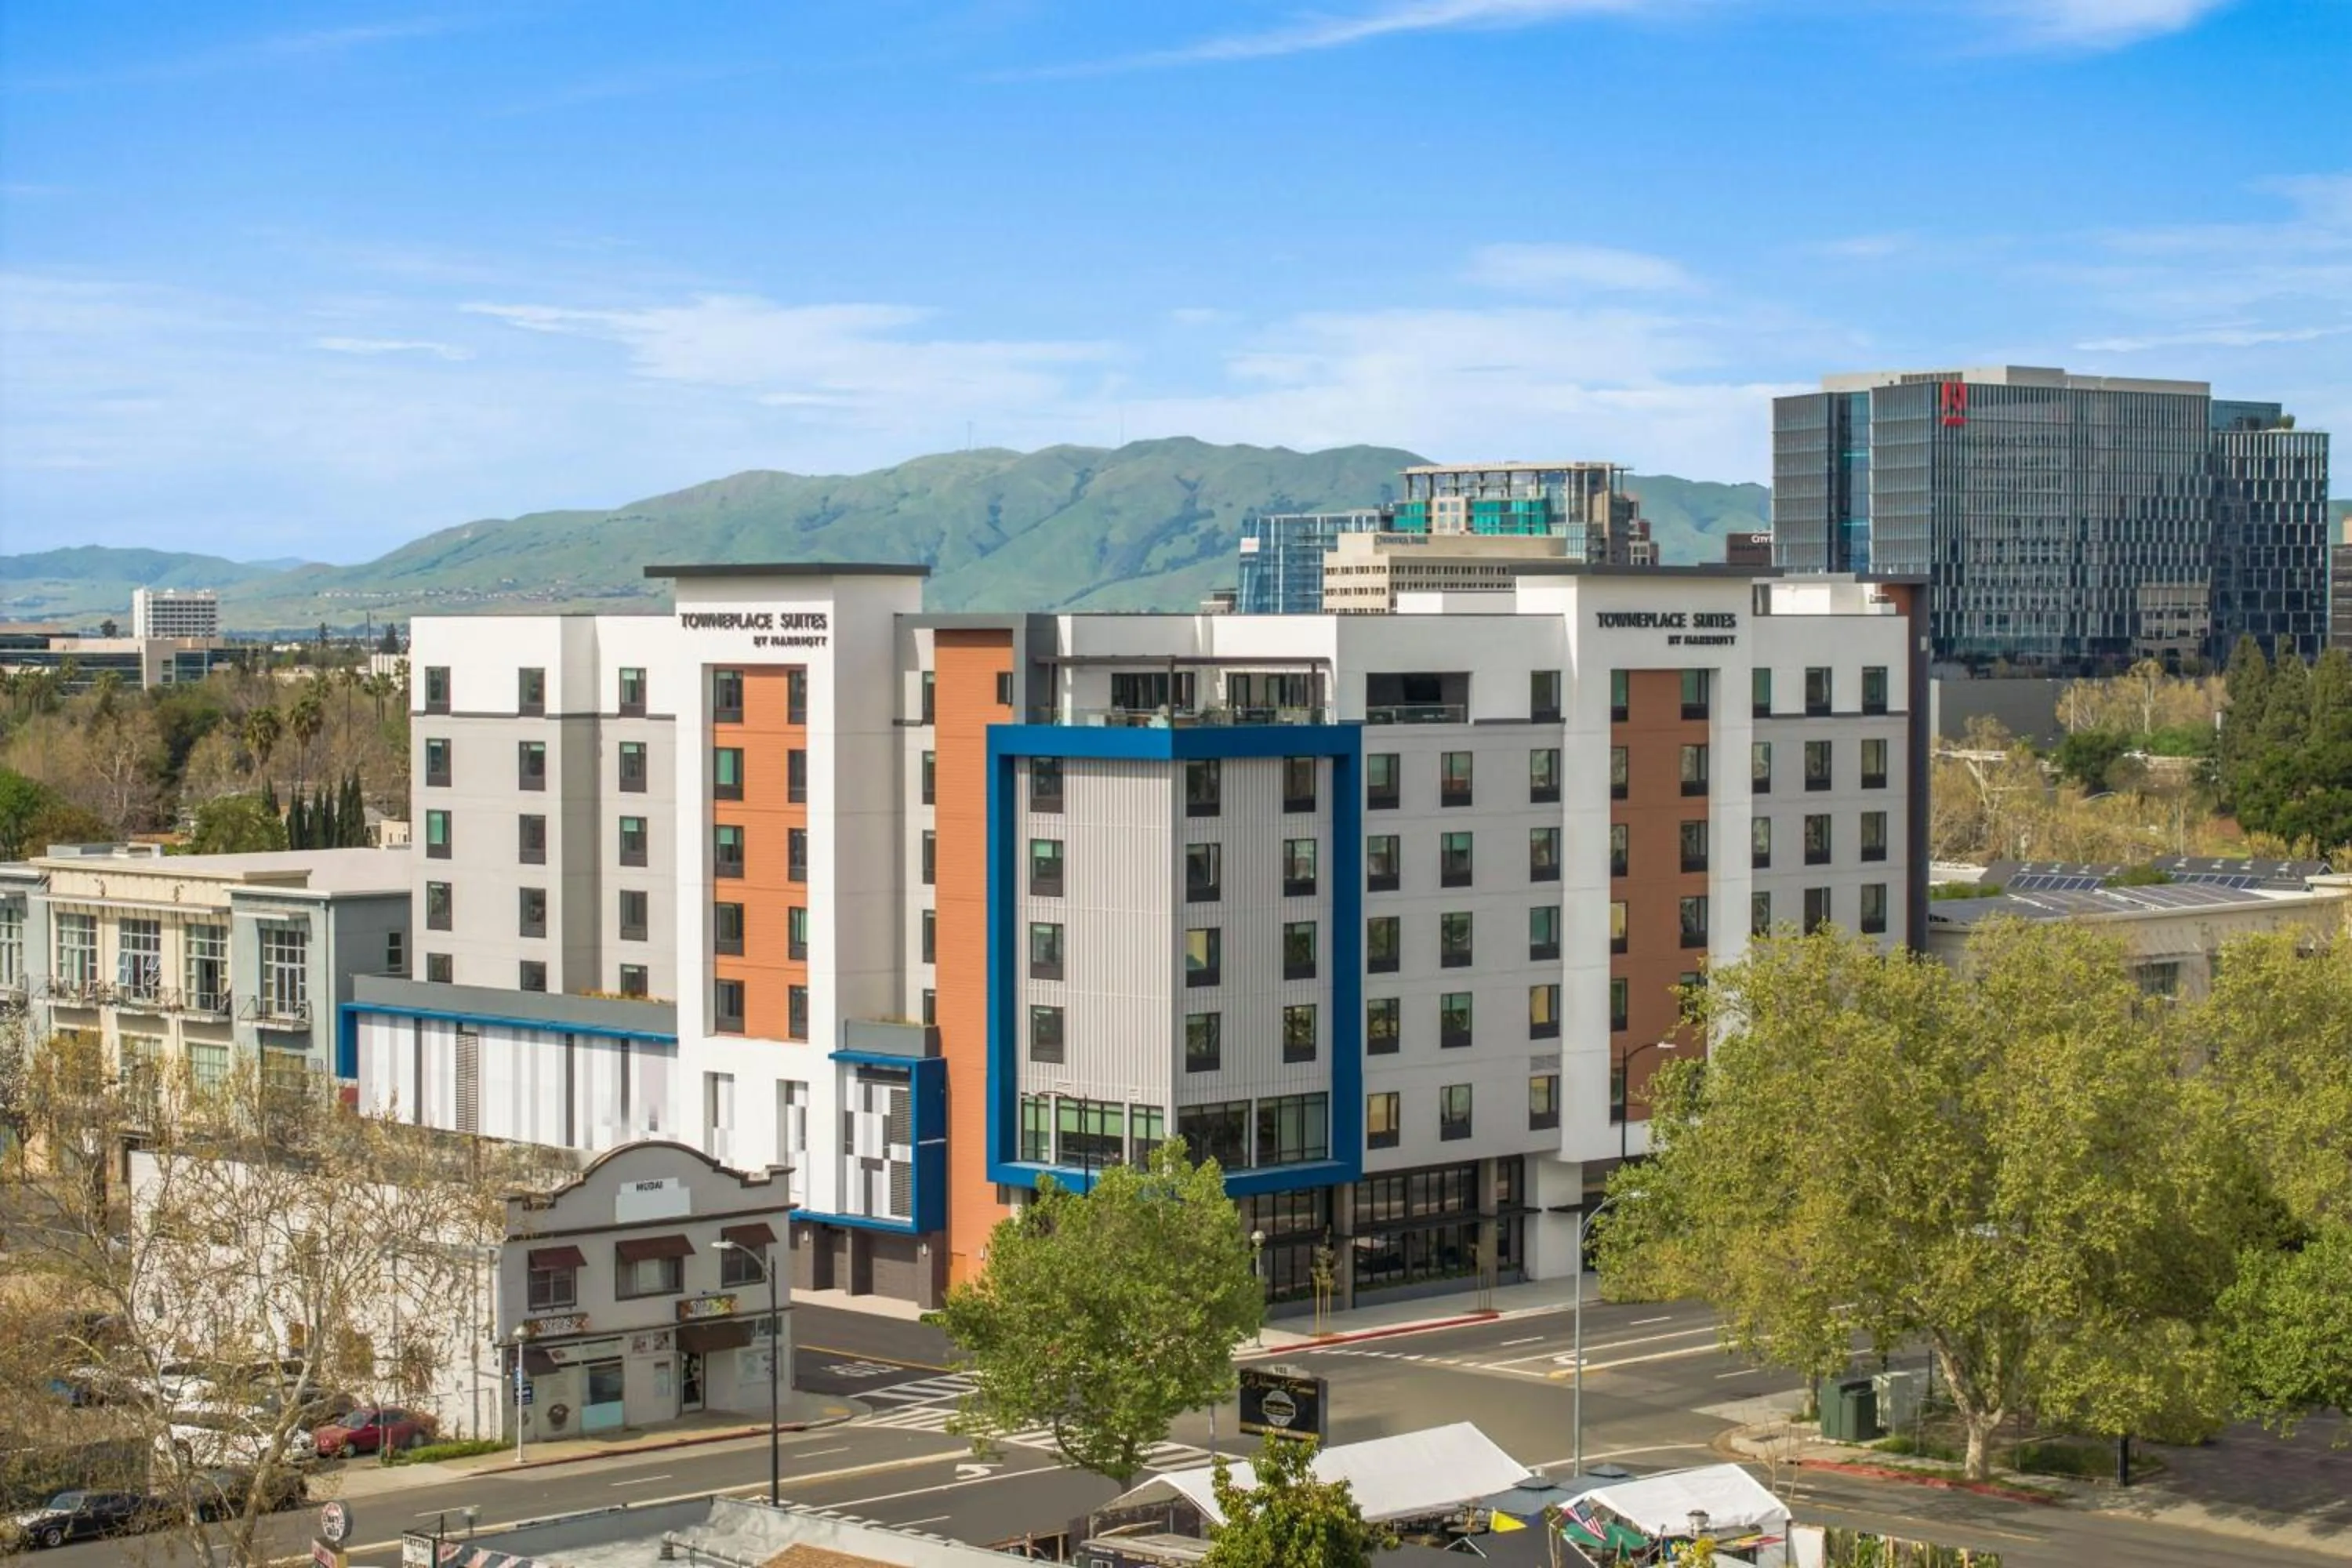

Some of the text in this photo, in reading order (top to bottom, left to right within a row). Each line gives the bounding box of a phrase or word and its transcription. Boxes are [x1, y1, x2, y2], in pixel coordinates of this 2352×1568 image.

[680, 613, 827, 629] TOWNEPLACE SUITES
[1596, 612, 1737, 628] TOWNEPLACE SUITES
[771, 636, 828, 647] MARRIOTT
[1684, 635, 1737, 645] MARRIOTT
